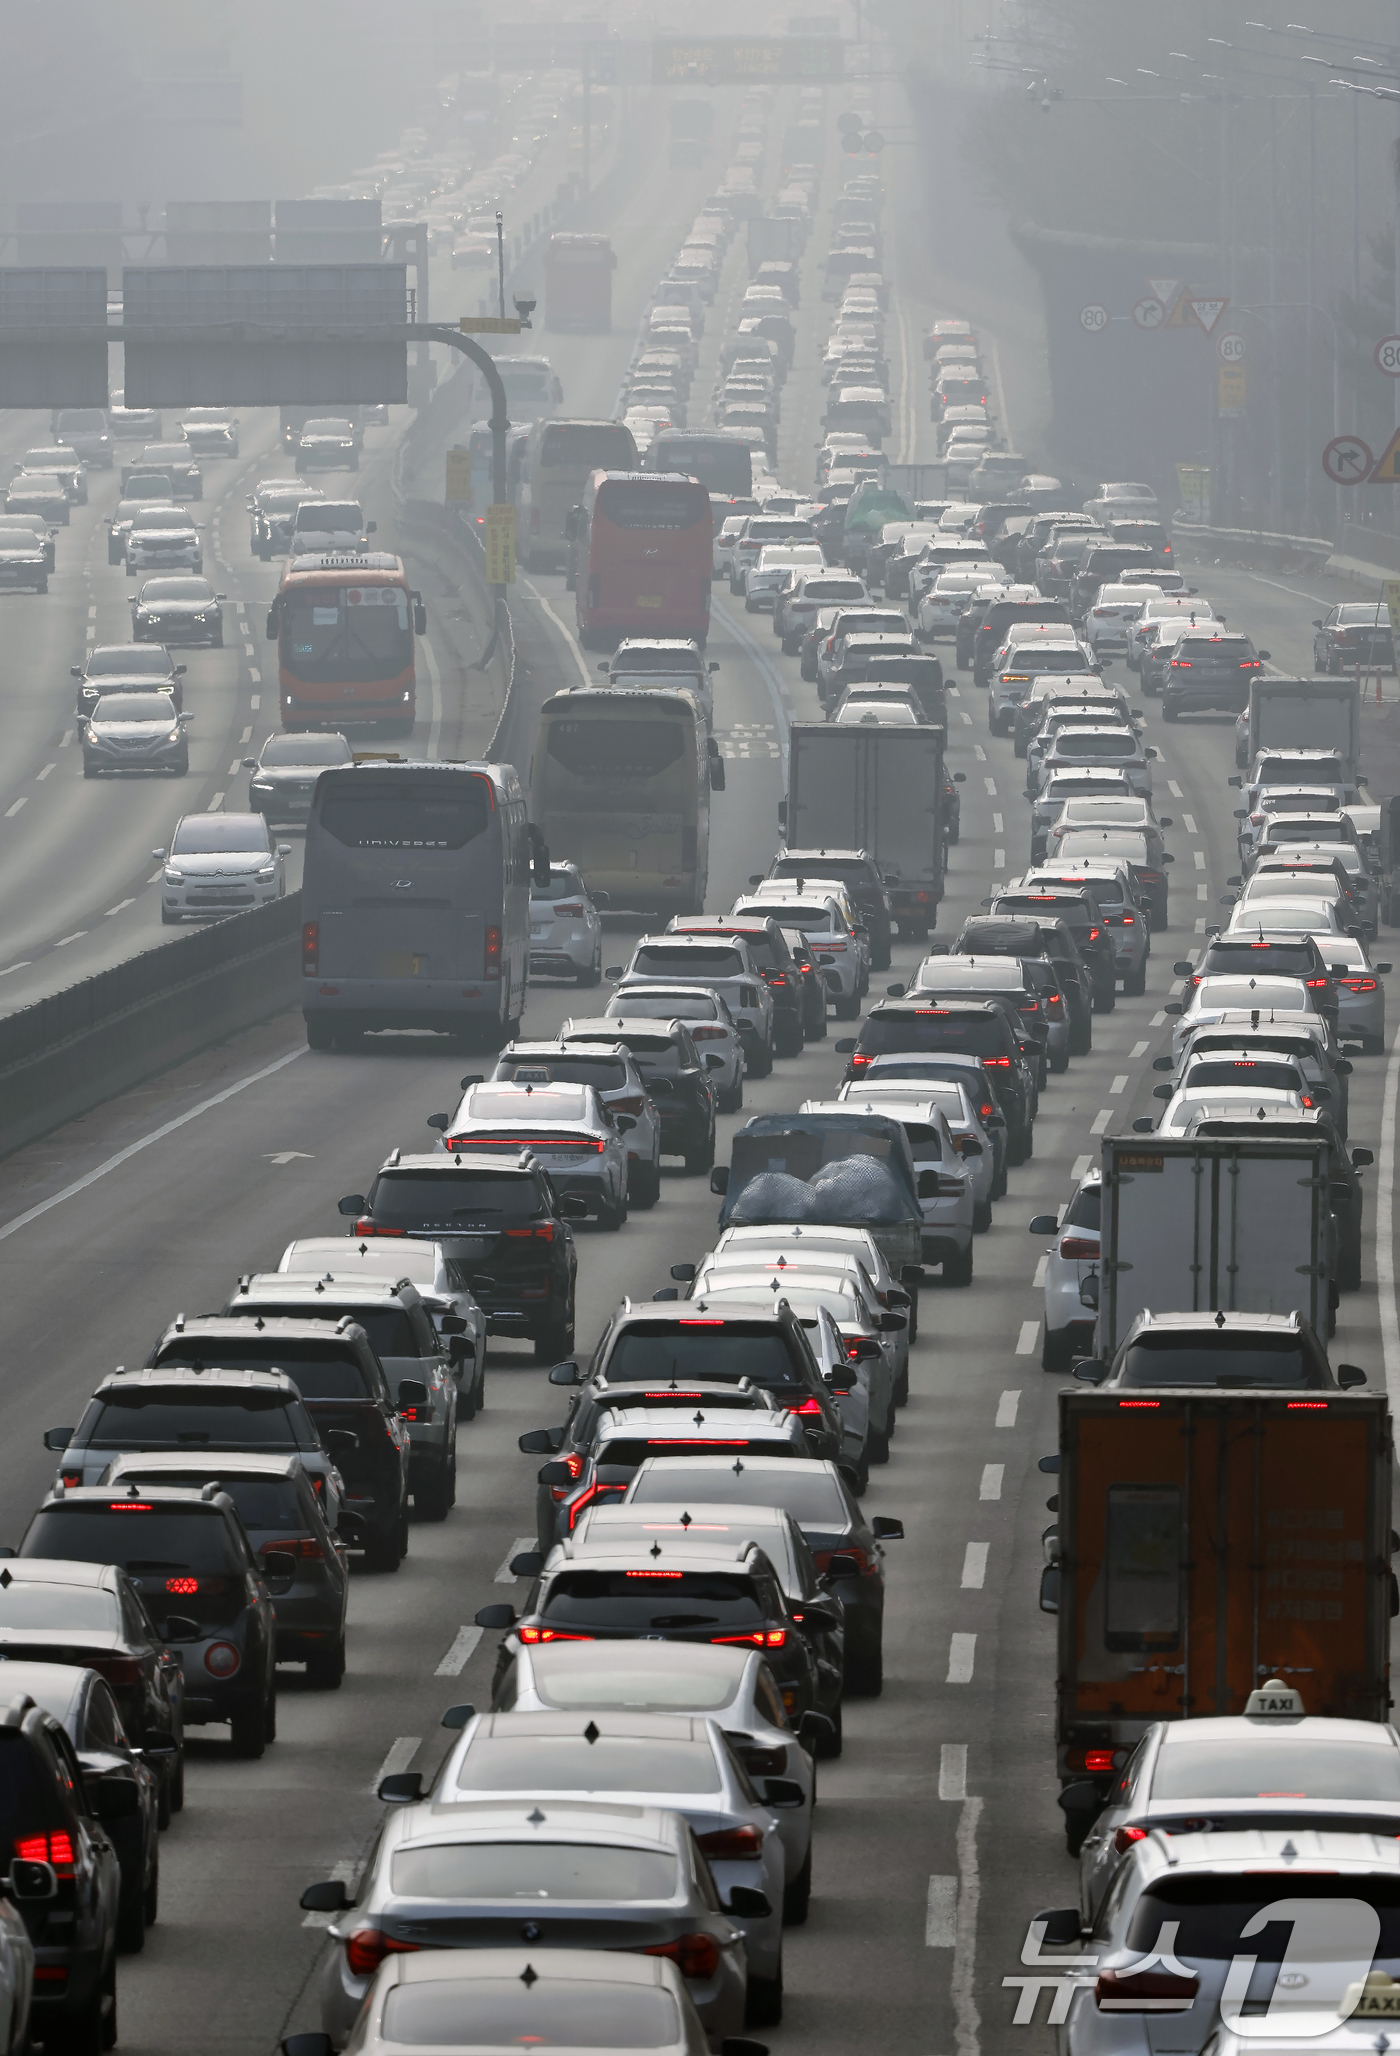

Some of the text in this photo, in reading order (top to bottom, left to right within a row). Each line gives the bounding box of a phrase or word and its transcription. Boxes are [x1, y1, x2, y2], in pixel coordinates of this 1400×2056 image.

[1197, 302, 1219, 312] 양보
[1084, 310, 1104, 327] 80
[1223, 340, 1244, 357] 80
[1258, 1698, 1294, 1711] TAXI
[1359, 1996, 1400, 2011] TAXI
